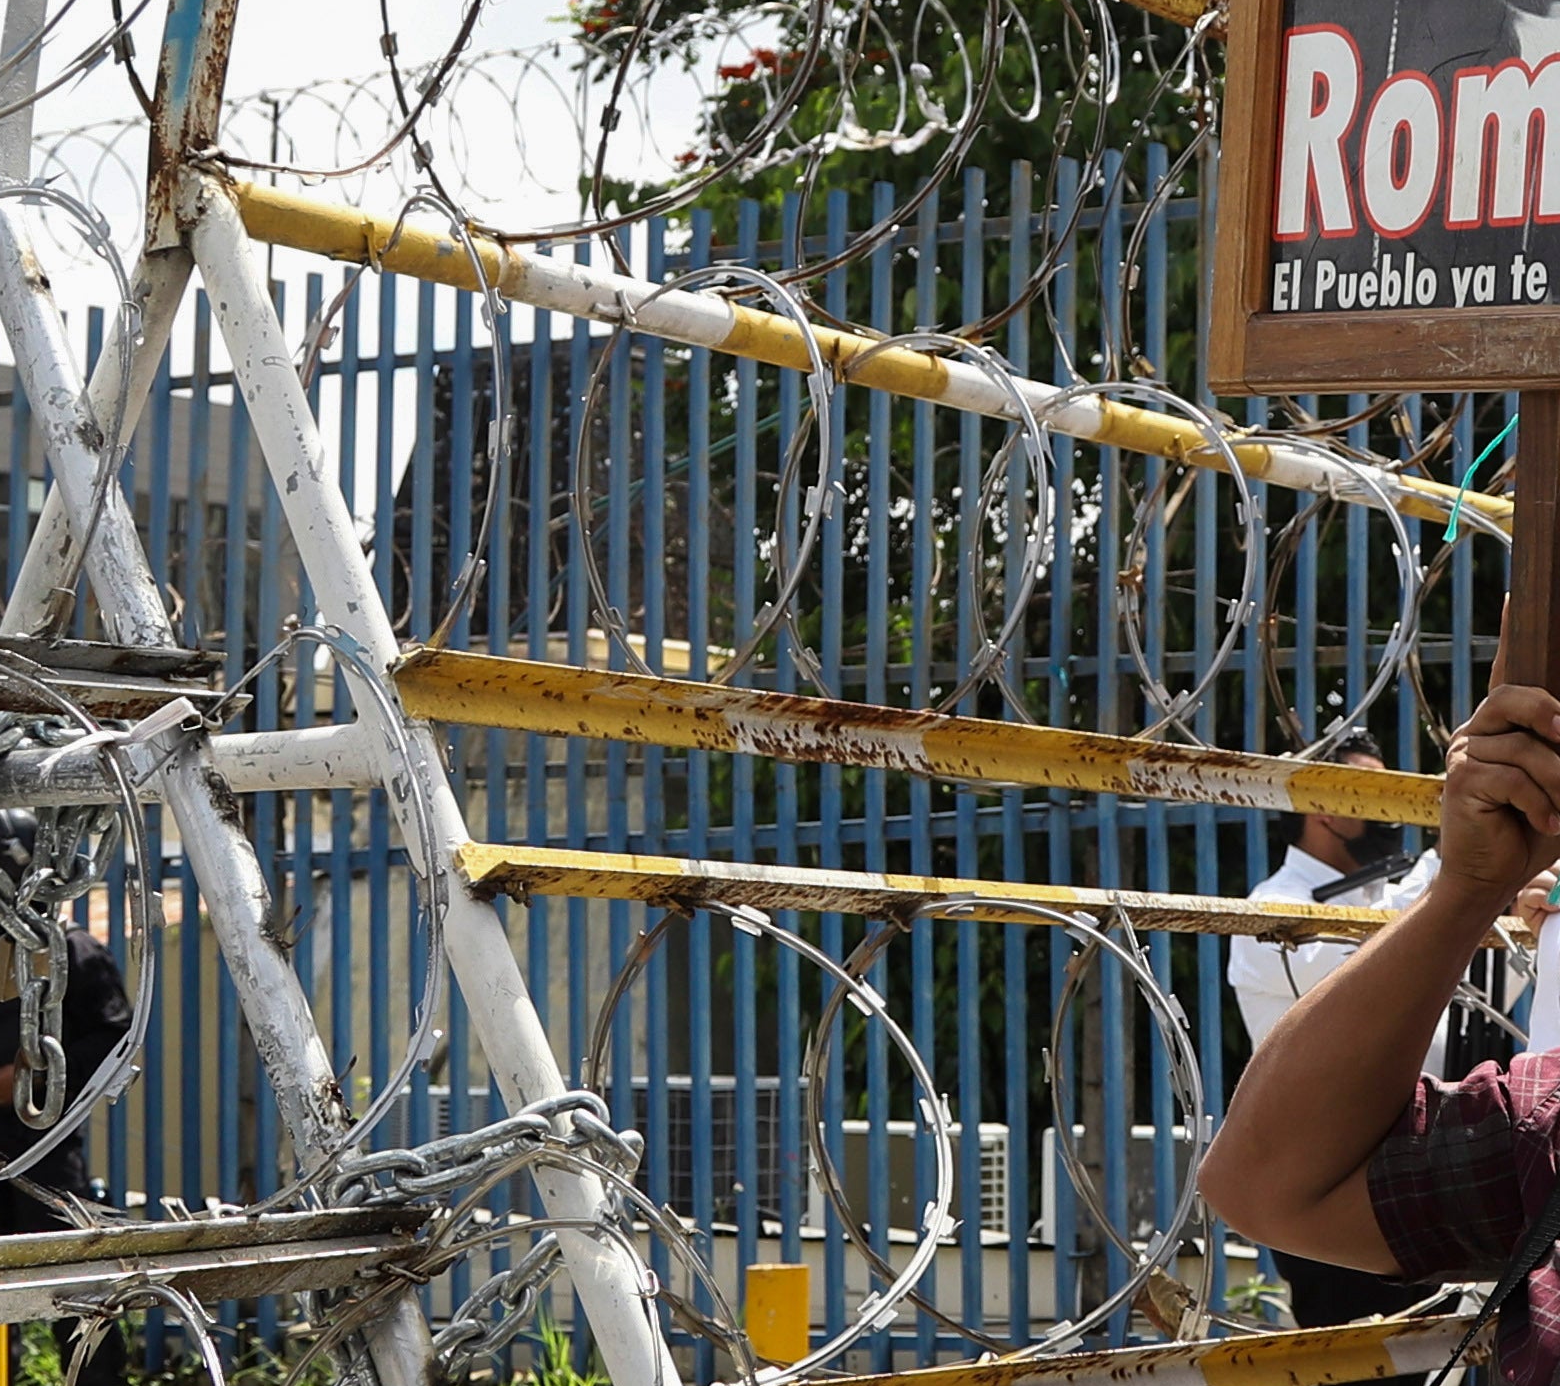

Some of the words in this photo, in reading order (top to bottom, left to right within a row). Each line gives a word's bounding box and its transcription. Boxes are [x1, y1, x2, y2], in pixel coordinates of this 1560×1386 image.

[1273, 262, 1301, 311] El
[1315, 253, 1437, 311] Pueblo
[1450, 262, 1495, 308] ya
[1509, 253, 1548, 301] te
